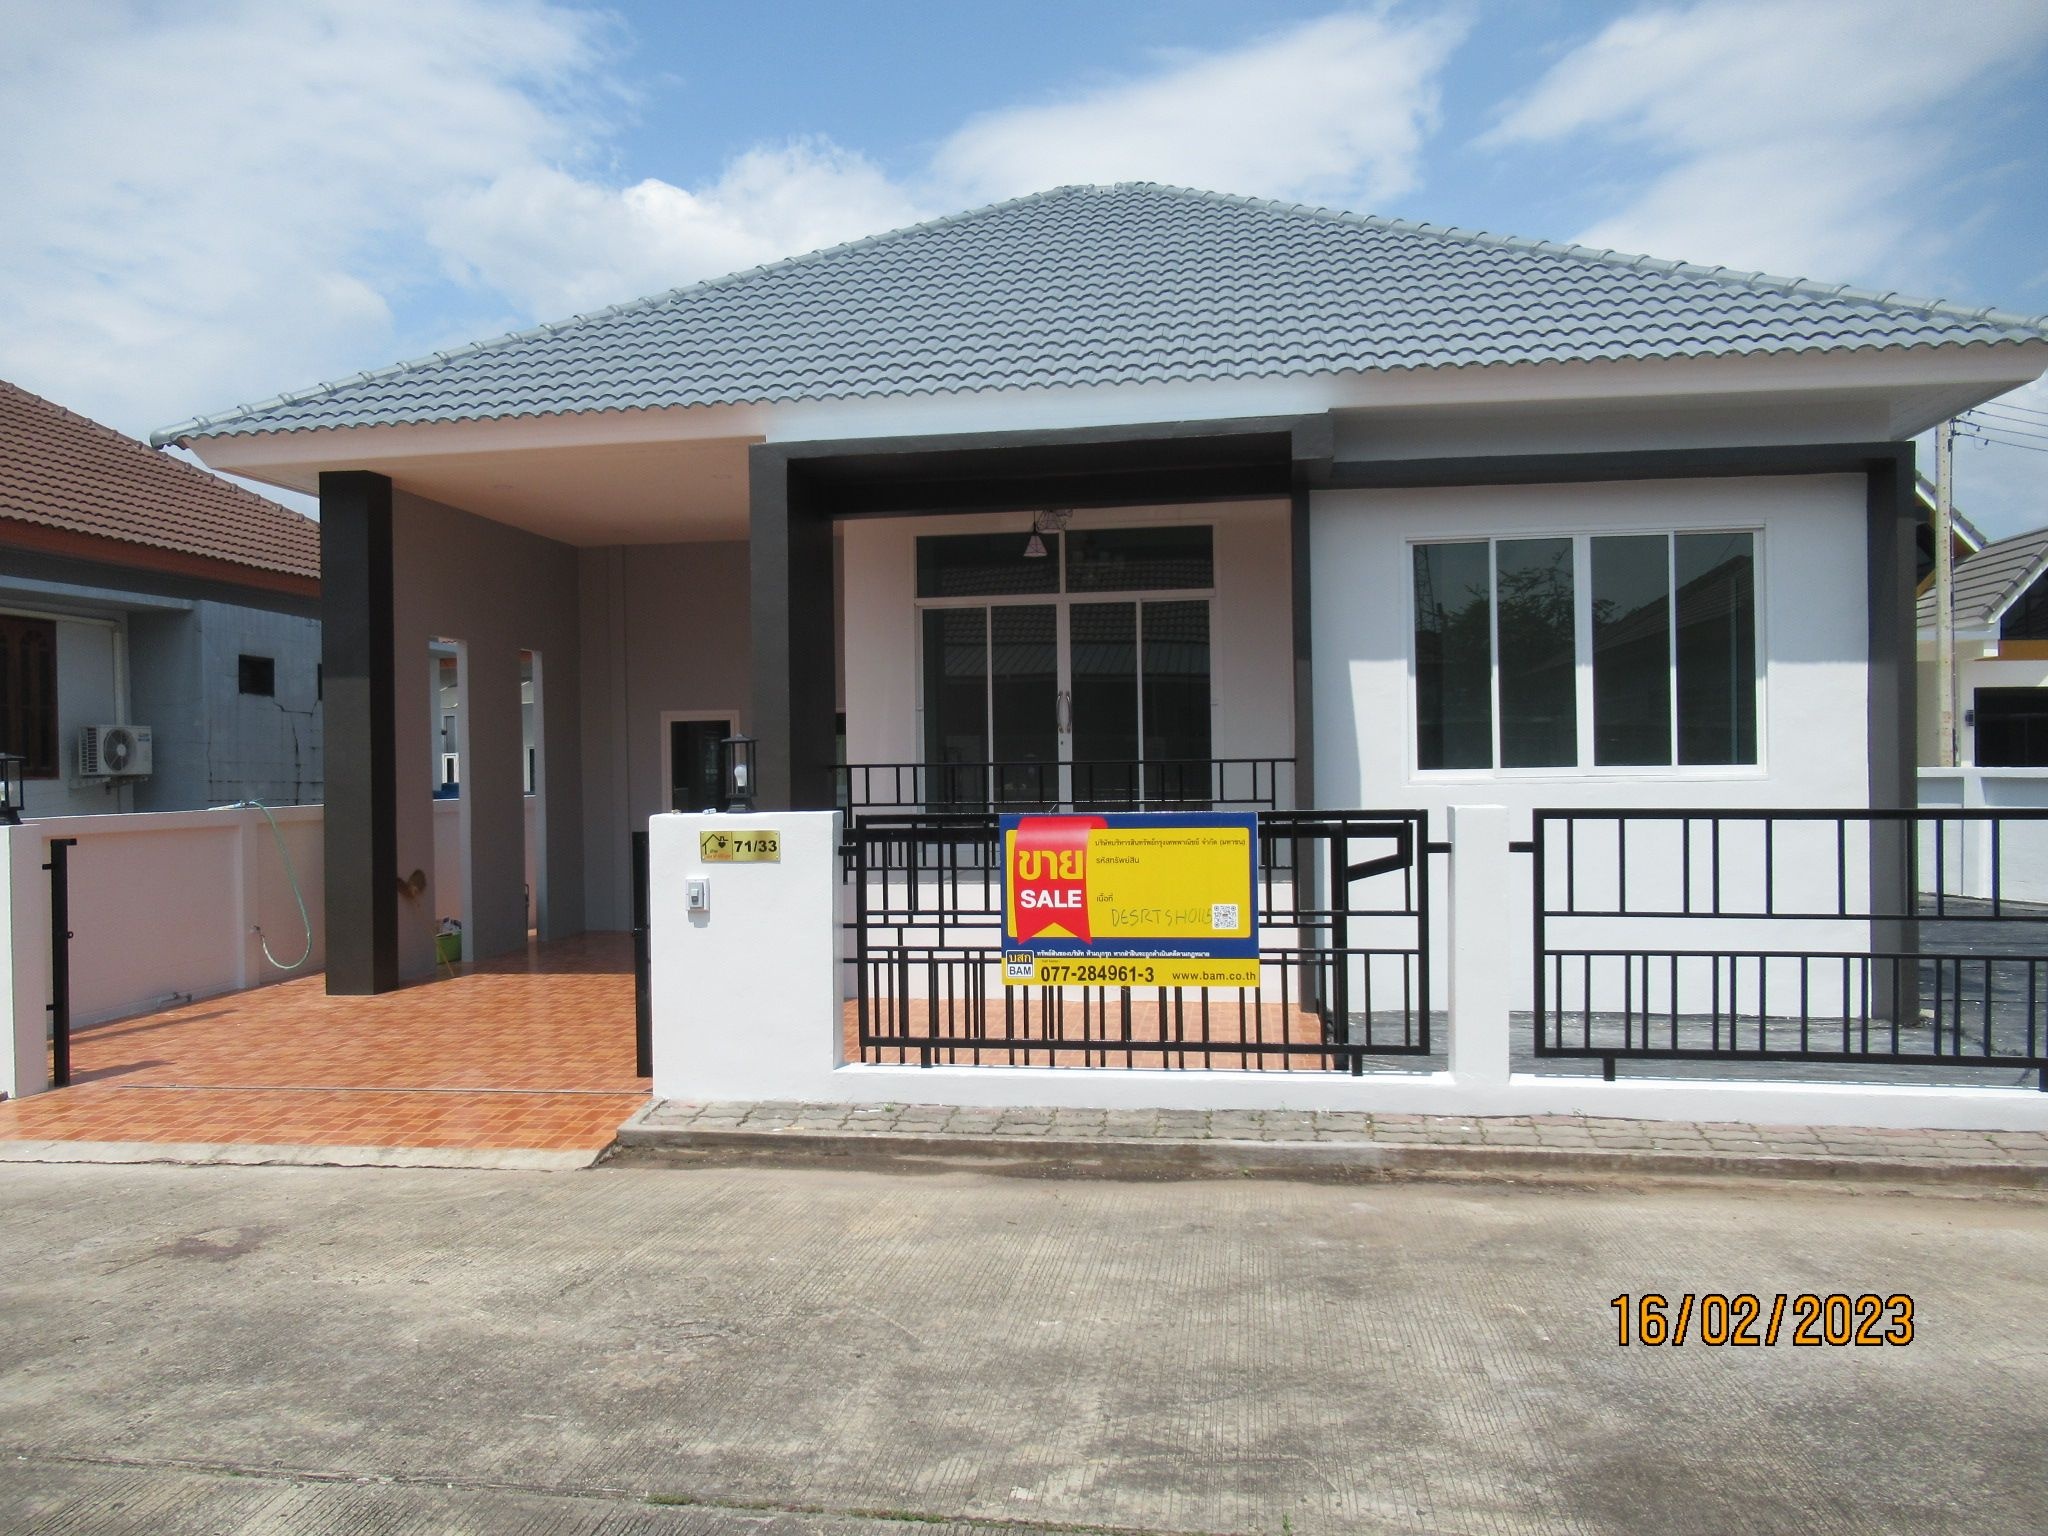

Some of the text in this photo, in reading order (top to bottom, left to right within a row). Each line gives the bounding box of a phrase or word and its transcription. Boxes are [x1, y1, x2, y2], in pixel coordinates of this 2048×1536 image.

[734, 840, 777, 852] 71/33
[1019, 850, 1084, 880] ขาย
[1096, 856, 1140, 864] รหัสทรัพย์สิน
[1020, 889, 1082, 908] SALE
[1096, 893, 1114, 902] เนื้อที่
[1009, 953, 1032, 963] บสก
[1009, 966, 1032, 976] BAM
[1041, 965, 1256, 982] 077-284961-3 www.bam.co.th
